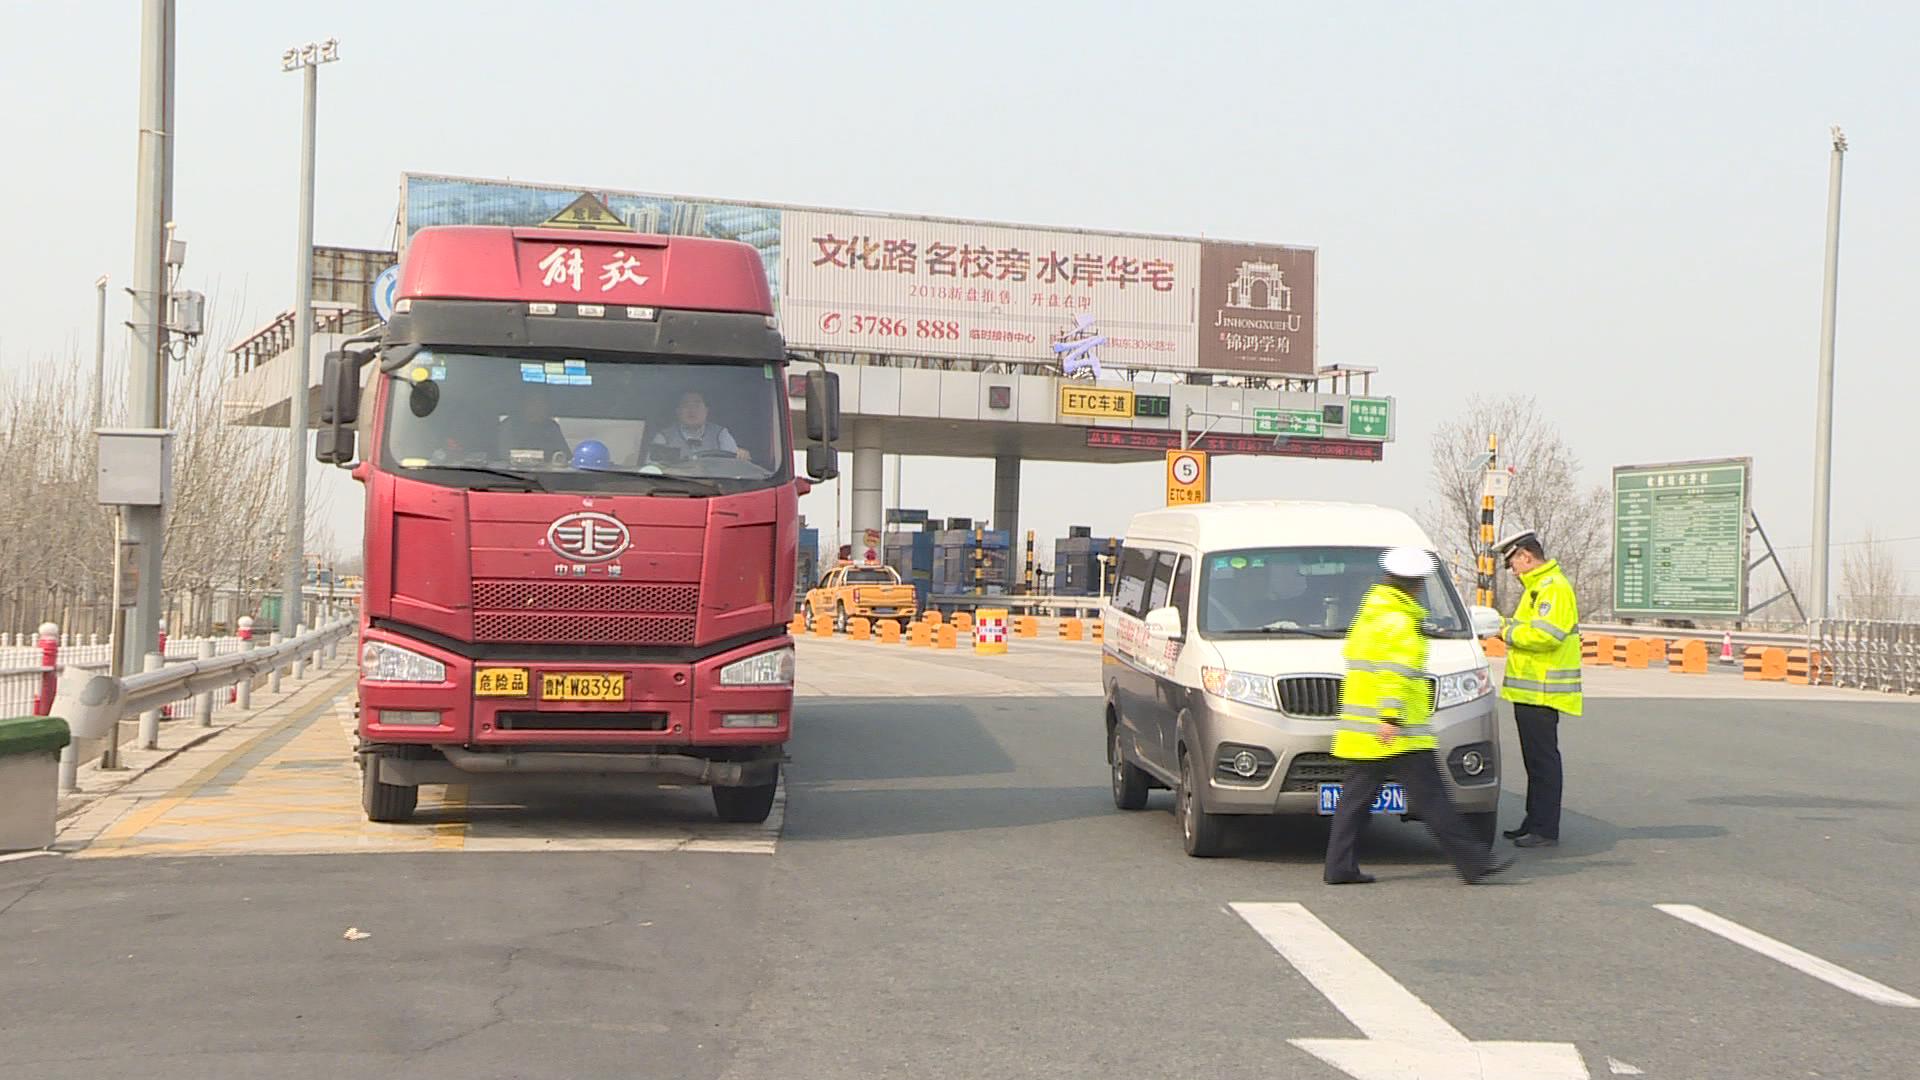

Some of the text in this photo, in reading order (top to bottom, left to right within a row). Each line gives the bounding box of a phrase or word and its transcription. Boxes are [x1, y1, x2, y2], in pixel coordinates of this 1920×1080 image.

[538, 246, 650, 293] 解放
[812, 233, 1175, 292] 文化路 名校旁 水岸华宅
[849, 314, 908, 338] 3786
[916, 318, 961, 341] 888
[1214, 309, 1302, 332] JINHONGXUEFU
[1225, 331, 1291, 354] 锦鸿学府
[1068, 394, 1126, 413] ETC车道
[1137, 397, 1169, 416] ETC
[1182, 464, 1193, 477] 5
[1169, 487, 1202, 503] ETC专用
[479, 673, 525, 692] 危险品
